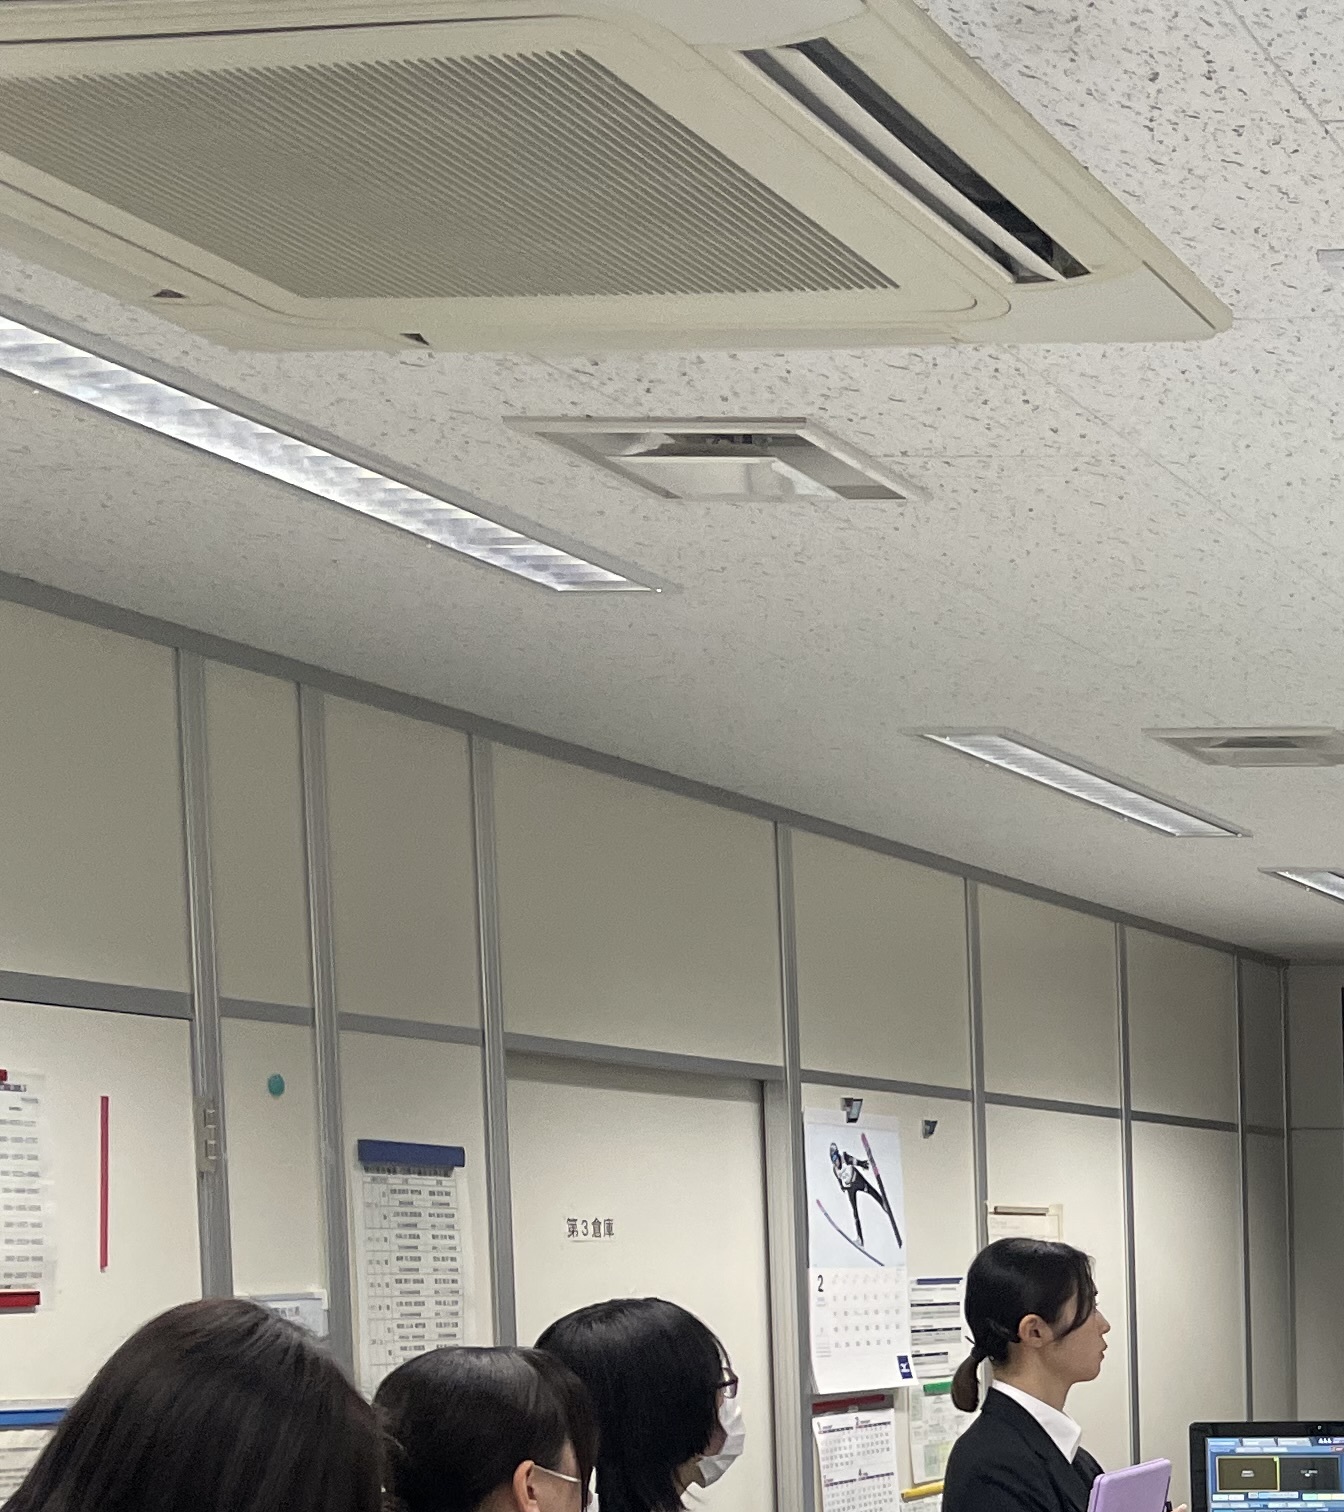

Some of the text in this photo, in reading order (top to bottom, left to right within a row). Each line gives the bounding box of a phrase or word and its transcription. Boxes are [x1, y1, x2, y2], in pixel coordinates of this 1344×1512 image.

[566, 1217, 615, 1238] 第3倉庫
[817, 1274, 824, 1292] 2
